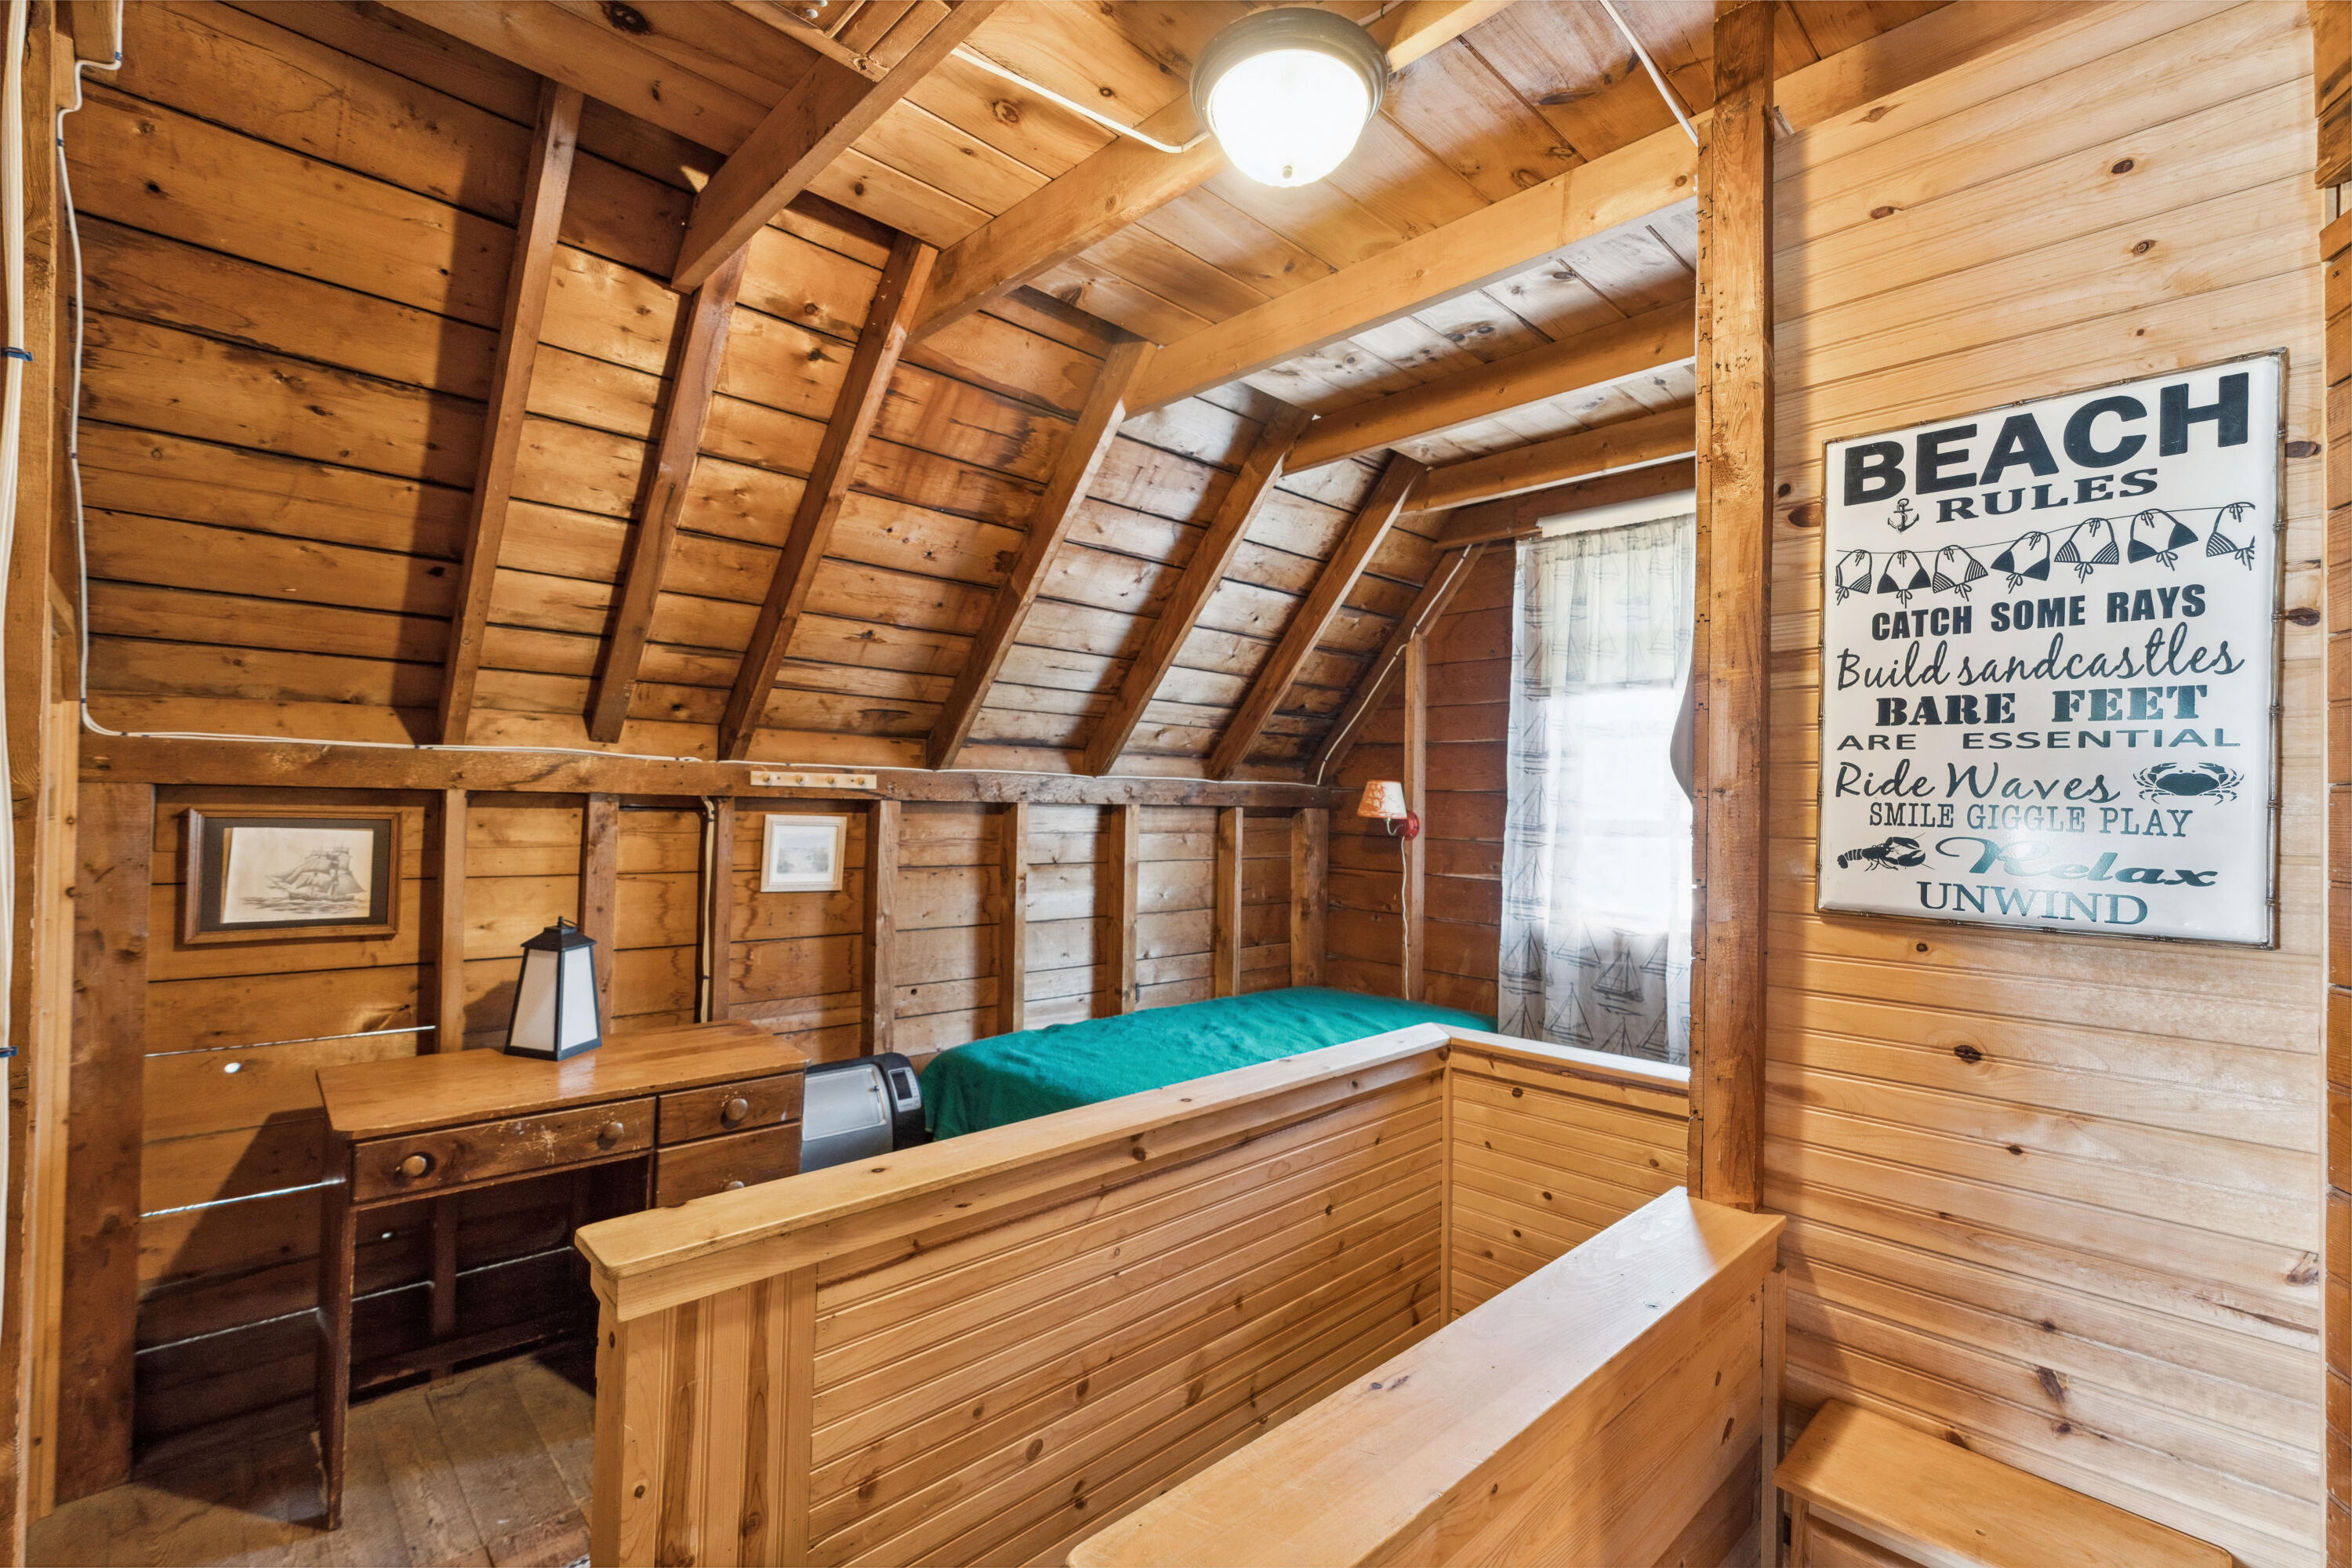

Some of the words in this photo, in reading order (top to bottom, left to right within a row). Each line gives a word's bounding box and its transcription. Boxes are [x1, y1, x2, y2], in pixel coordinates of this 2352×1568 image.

[1844, 372, 2249, 506] BEACH
[1936, 468, 2158, 524] RULES
[1871, 605, 1973, 641] CATCH
[1991, 595, 2085, 632] SOME
[2107, 584, 2206, 622] RAYS
[1837, 641, 1950, 691] Build
[1957, 622, 2245, 687] sandcastles
[1875, 693, 2016, 727] BARE
[2052, 684, 2208, 723] FEET
[1837, 734, 1917, 751] ARE
[1962, 729, 2241, 750] ESSENTIAL
[1835, 758, 1935, 798] Ride
[1946, 762, 2121, 804] Waves
[1869, 802, 1955, 829] SMILE
[1966, 804, 2085, 833] GIGGLE
[2098, 807, 2194, 837] PLAY
[1935, 837, 2219, 887] Relax
[1916, 881, 2149, 925] UNWIND
